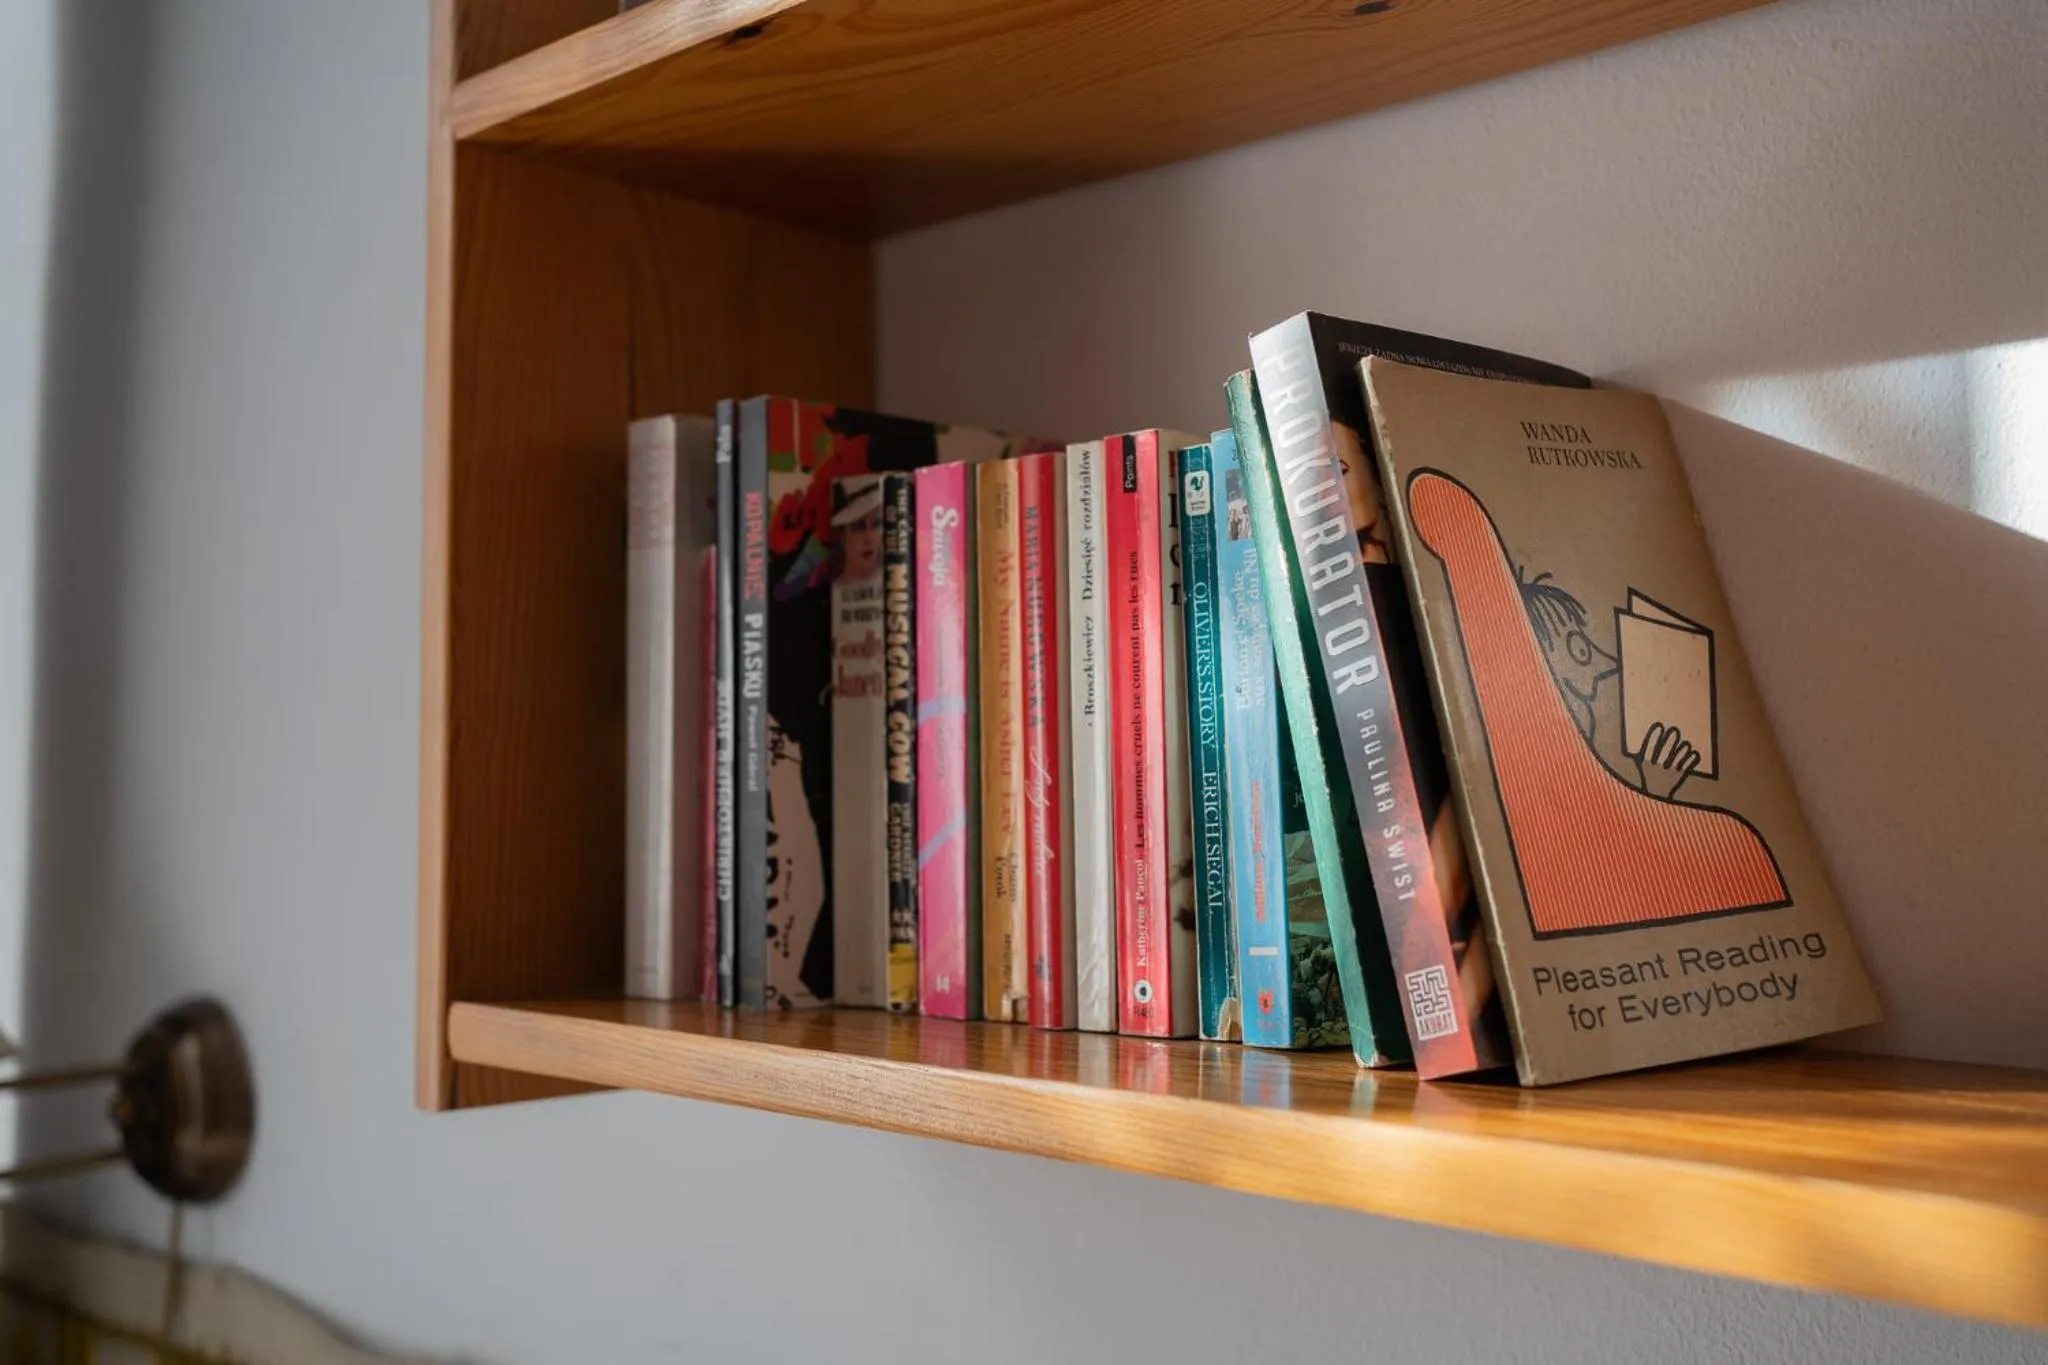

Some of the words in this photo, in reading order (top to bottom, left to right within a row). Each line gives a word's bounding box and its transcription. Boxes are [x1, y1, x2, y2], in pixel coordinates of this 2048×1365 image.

[1520, 421, 1592, 444] WANDA
[1527, 446, 1641, 469] RUTKOWSKA
[1079, 450, 1092, 531] rozdziałów
[1124, 455, 1135, 489] Points
[744, 492, 763, 600] KOPALNIE
[929, 505, 960, 587] Szwaja
[1025, 506, 1040, 571] MARIA
[1260, 346, 1379, 695] PROKURATOR
[994, 549, 1015, 586] My
[1081, 539, 1096, 600] Dziesięć
[1128, 552, 1140, 581] rues
[1244, 549, 1259, 574] Nil
[1247, 578, 1261, 600] du
[1128, 586, 1140, 605] les
[1131, 612, 1144, 631] pas
[1230, 571, 1247, 625] Speke
[743, 613, 764, 699] PIASKU
[887, 562, 909, 701] MUSICAL
[997, 604, 1014, 673] Name
[1027, 577, 1046, 729] NUROWSKA
[1130, 636, 1142, 690] courent
[1194, 582, 1212, 681] OLIVER'S
[1001, 680, 1013, 699] is
[1083, 616, 1096, 716] Broszkiewicz
[1132, 694, 1142, 710] ne
[1199, 684, 1216, 749] STORY
[889, 711, 910, 783] COW
[1000, 707, 1015, 778] Asher
[1131, 716, 1143, 757] cruels
[1001, 789, 1014, 835] Lev
[1133, 758, 1145, 821] hommes
[1203, 771, 1222, 837] ERICH
[1356, 707, 1395, 814] PAULINA
[1382, 824, 1417, 902] ŚWIST
[717, 754, 733, 900] CHRISTOPHER
[1135, 824, 1145, 849] Les
[1206, 843, 1224, 907] SEGAL
[1135, 903, 1148, 967] Katherine
[1532, 953, 1669, 996] Pleasant
[1678, 932, 1827, 976] Reading
[1567, 1003, 1607, 1032] for
[1617, 972, 1798, 1025] Everybody
